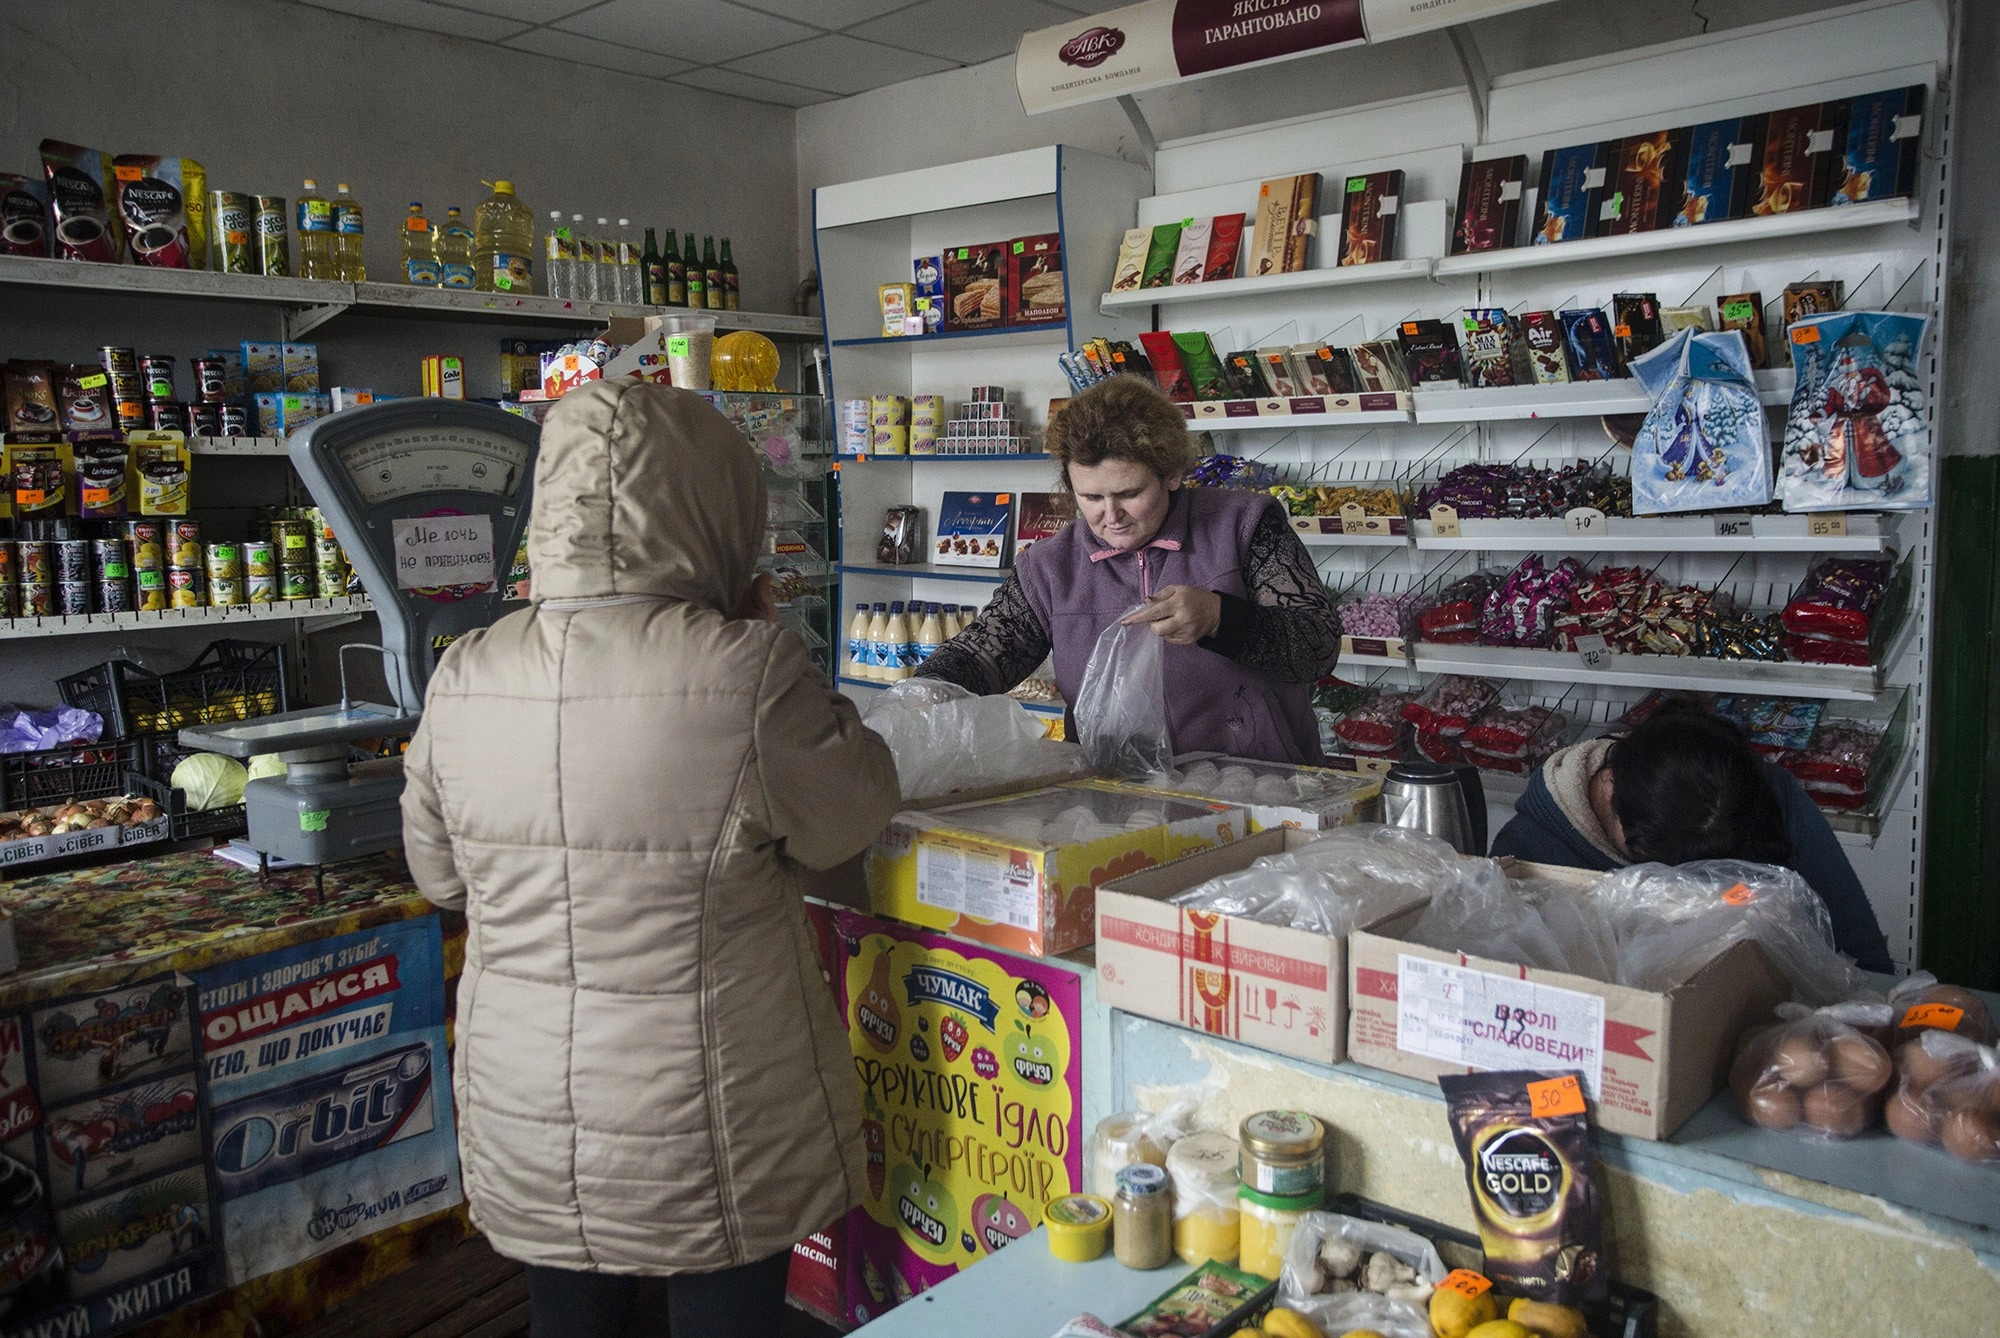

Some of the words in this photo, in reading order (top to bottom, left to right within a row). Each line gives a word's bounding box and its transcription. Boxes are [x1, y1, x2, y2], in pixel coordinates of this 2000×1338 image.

[1205, 4, 1321, 45] ГАРАНТОВАНО
[1067, 33, 1116, 56] АВК
[1051, 77, 1102, 92] КОНДИТЕРСЬКА
[1105, 66, 1141, 79] КОМПАНІЯ
[1629, 178, 1644, 234] MONTERINI
[1024, 308, 1060, 316] НАПОЛЕОН
[1475, 334, 1496, 343] MAX
[1528, 327, 1552, 341] Air
[1478, 343, 1497, 351] FUN
[444, 370, 460, 379] Сода
[1575, 516, 1591, 530] 70
[1720, 522, 1738, 535] 145
[1813, 523, 1829, 534] 85
[406, 526, 479, 547] Мелочь
[776, 544, 806, 552] НОВИНКА
[400, 552, 417, 570] не
[1585, 650, 1599, 665] 72
[262, 952, 334, 993] ЗДОРОВ'Я
[337, 939, 379, 969] ЗУБІВ
[1231, 950, 1286, 974] ВИРОБИ
[202, 963, 391, 1042] ОЩАЙСЯ
[918, 974, 982, 1011] ЧУМАК
[860, 1005, 897, 1044] ФРУЗІ
[257, 1041, 290, 1071] ЩО
[299, 1011, 386, 1059] ДОКУЧАЄ
[1016, 1058, 1051, 1082] ФРУЗІ
[855, 1055, 985, 1125] ФРУКТОВЕ
[1538, 1090, 1560, 1110] 50
[214, 1075, 397, 1174] Orbit
[1486, 1173, 1551, 1194] GOLD
[901, 1195, 946, 1244] ФРУЗІ
[793, 1242, 838, 1271] паста!
[109, 1267, 193, 1324] ЖИТТЯ
